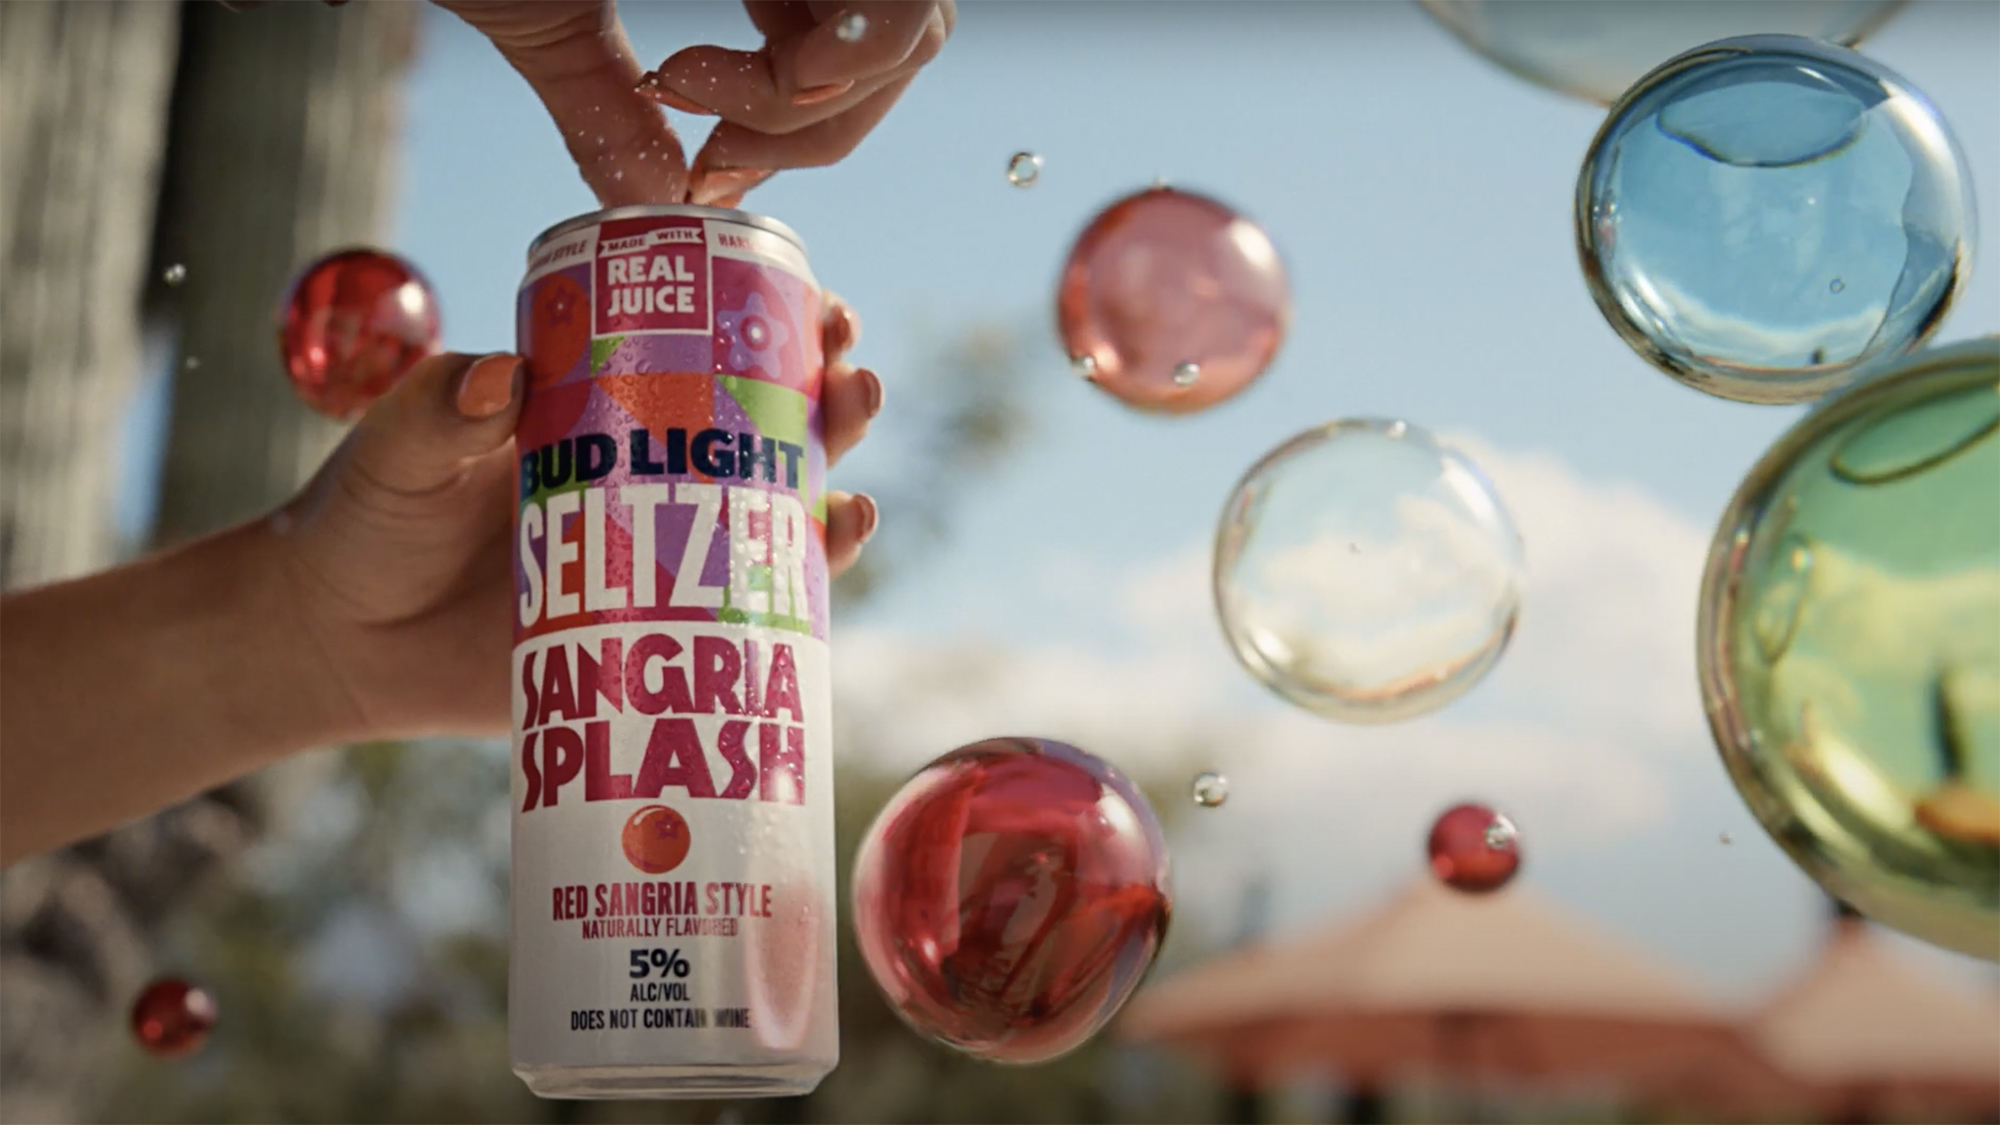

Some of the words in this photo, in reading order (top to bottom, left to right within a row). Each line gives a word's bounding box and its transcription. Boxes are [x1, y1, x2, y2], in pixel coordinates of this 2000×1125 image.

[607, 237, 645, 252] MADE
[656, 230, 694, 240] WITH
[607, 255, 694, 285] REAL
[607, 286, 695, 316] JUICE
[521, 433, 617, 496] BUD
[630, 428, 804, 489] LIGHT
[520, 483, 807, 628] SELTZER
[522, 633, 803, 731] SANGRIA
[522, 718, 805, 813] SPLASH
[553, 885, 588, 921] RED
[595, 881, 698, 917] SANGRIA
[705, 883, 772, 917] STYLE
[583, 918, 661, 939] NATURALLY
[666, 917, 738, 937] FLAVORED
[629, 948, 690, 979] 5%
[630, 982, 690, 1002] ALC/VOL
[571, 1010, 605, 1031] DOES
[610, 1009, 637, 1029] NOT
[643, 1008, 707, 1029] CONTAIN
[714, 1008, 750, 1028] WINE
